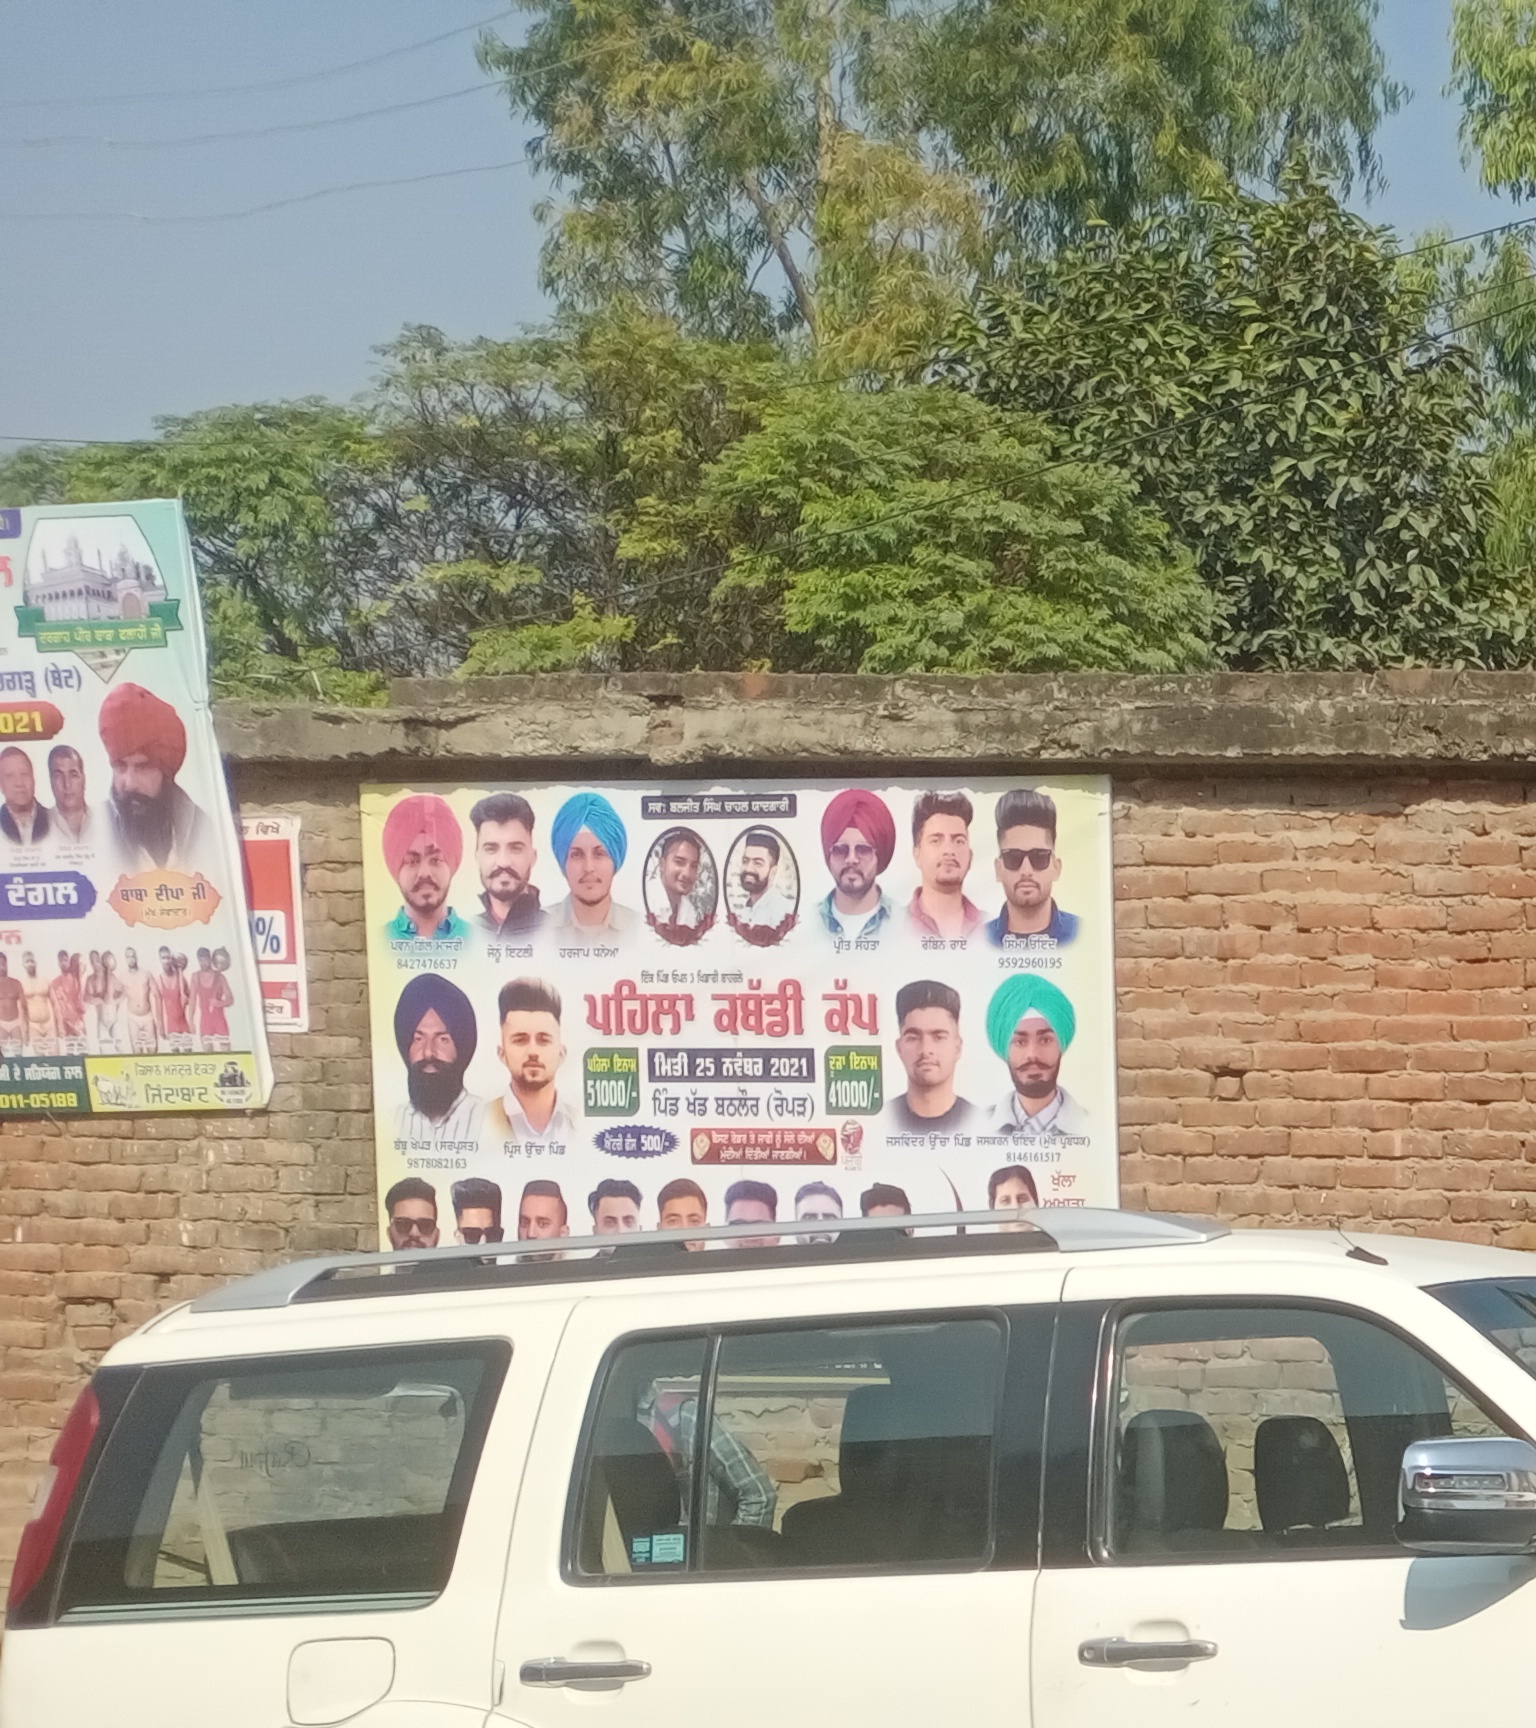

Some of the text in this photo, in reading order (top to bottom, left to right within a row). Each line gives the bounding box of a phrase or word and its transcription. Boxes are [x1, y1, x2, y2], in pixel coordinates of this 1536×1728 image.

[0, 711, 43, 733] 021
[998, 957, 1063, 969] 9592960195
[584, 978, 879, 1037] ਪਹਿਲਾ ਕਬੱਡੀ ਕੱਪ
[654, 1052, 689, 1077] ਮਿਤੀ
[695, 1058, 715, 1077] 25
[770, 1057, 808, 1077] 2021
[587, 1075, 638, 1110] 51000/-
[828, 1075, 880, 1110] 41000/-
